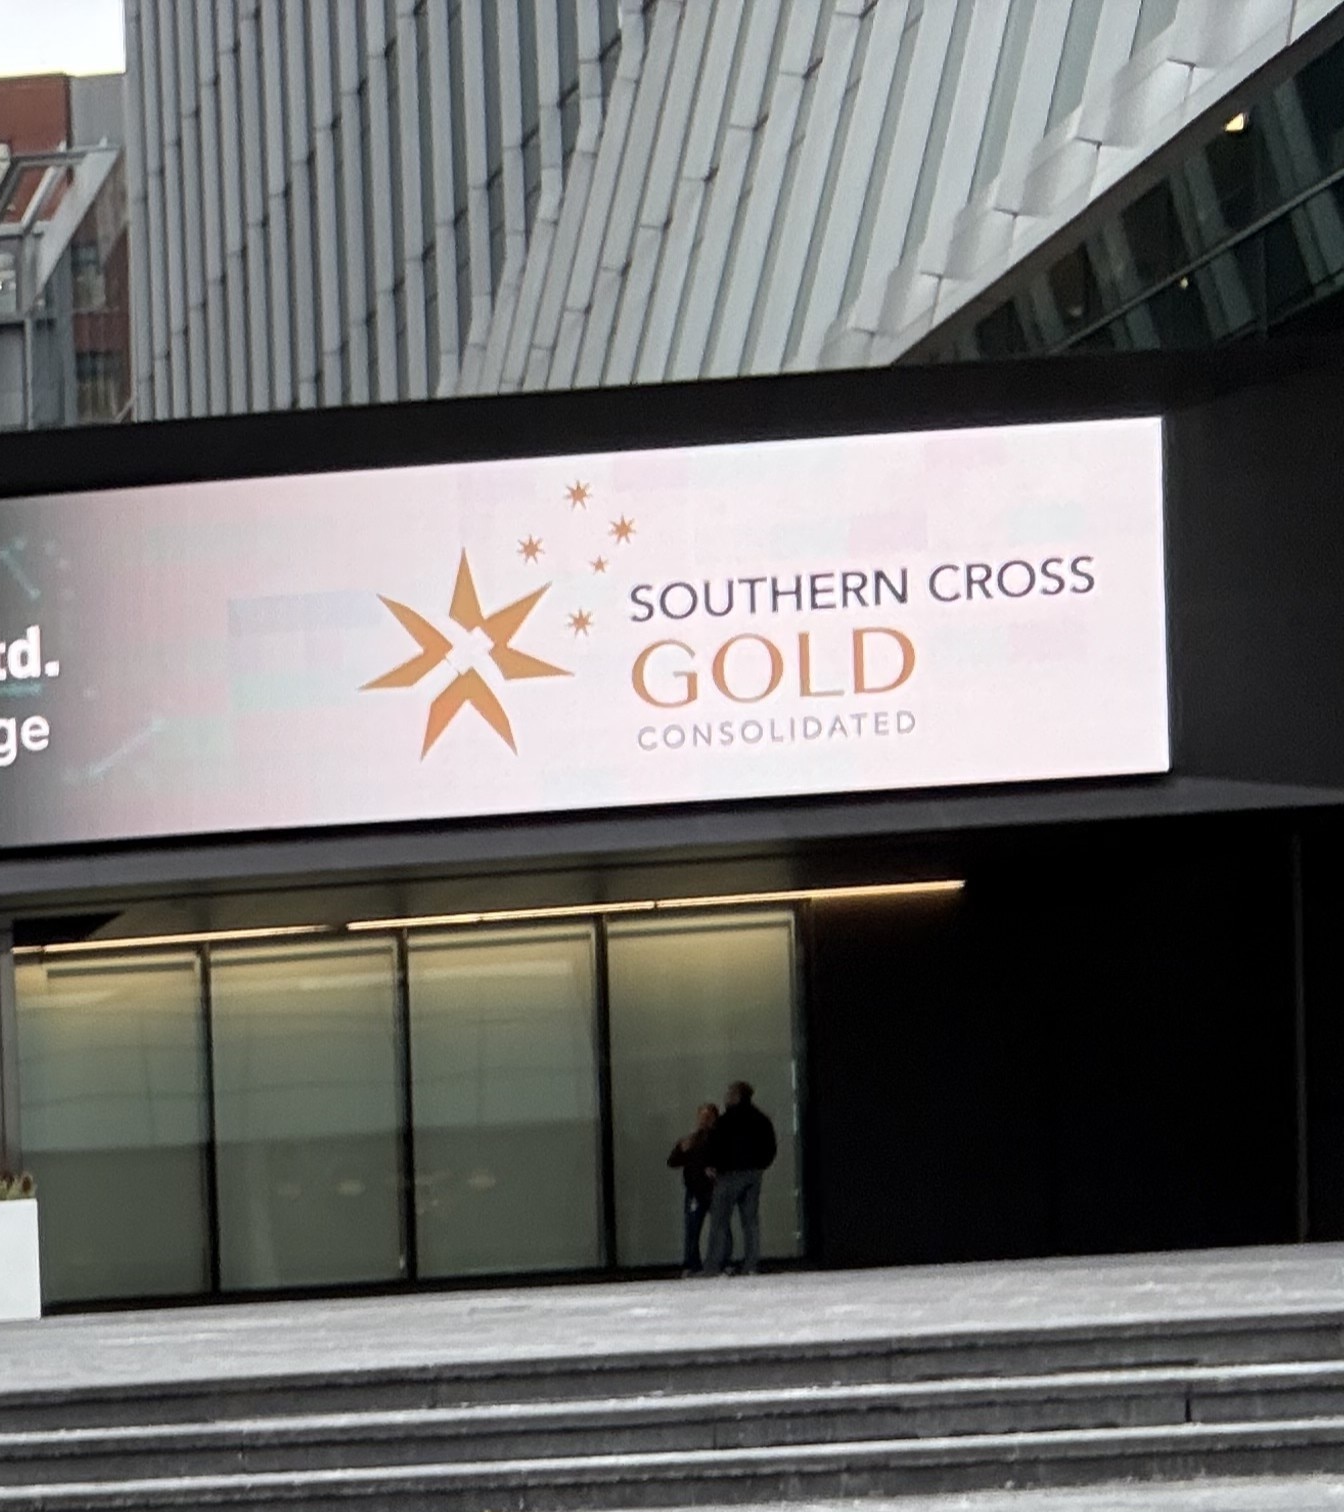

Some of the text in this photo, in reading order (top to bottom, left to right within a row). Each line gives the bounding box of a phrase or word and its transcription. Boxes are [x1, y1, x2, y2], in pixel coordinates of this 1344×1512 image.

[629, 555, 1096, 622] SOUTHERN CROSS
[632, 626, 916, 708] GOLD
[637, 710, 917, 751] CONSOLIDATED
